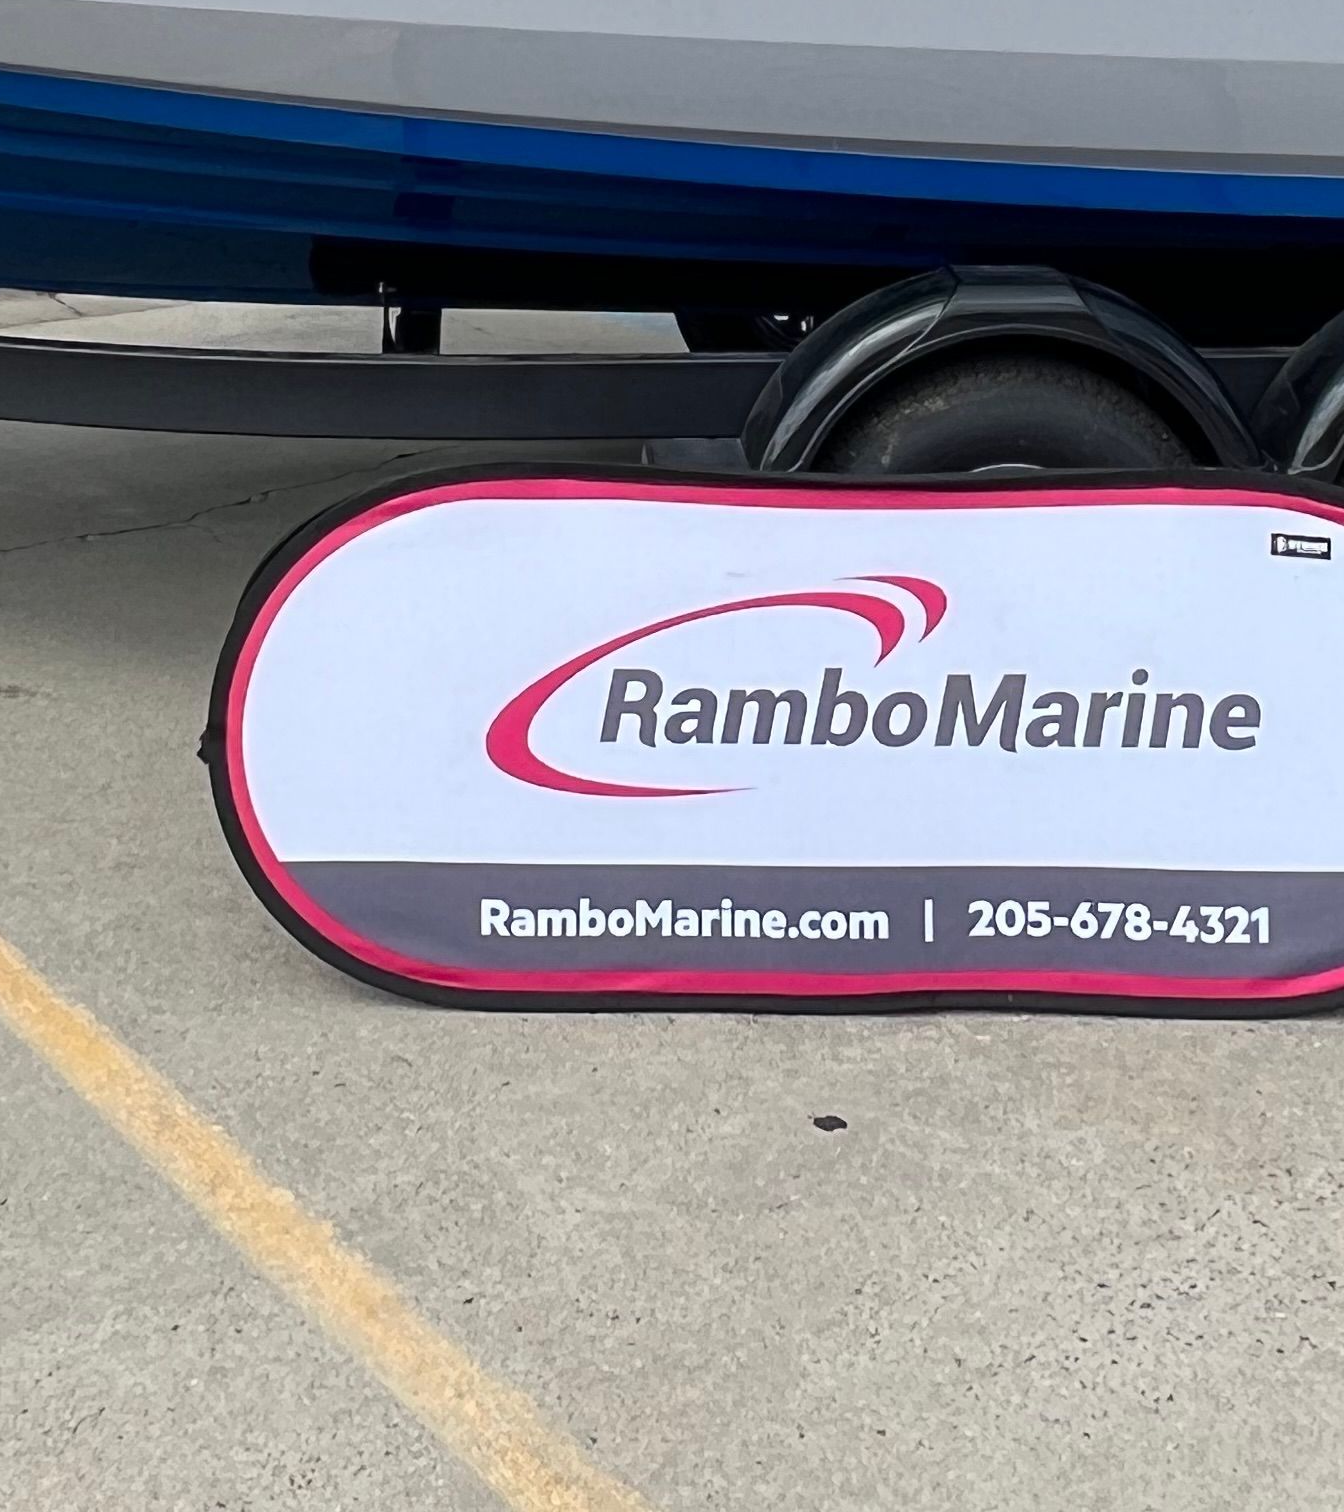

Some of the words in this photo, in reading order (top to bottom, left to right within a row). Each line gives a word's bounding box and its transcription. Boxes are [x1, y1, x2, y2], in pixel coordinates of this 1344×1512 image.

[600, 667, 1262, 754] RamboMarine
[478, 897, 890, 942] RamboMarine.com
[966, 899, 1271, 945] 205-678-4321
